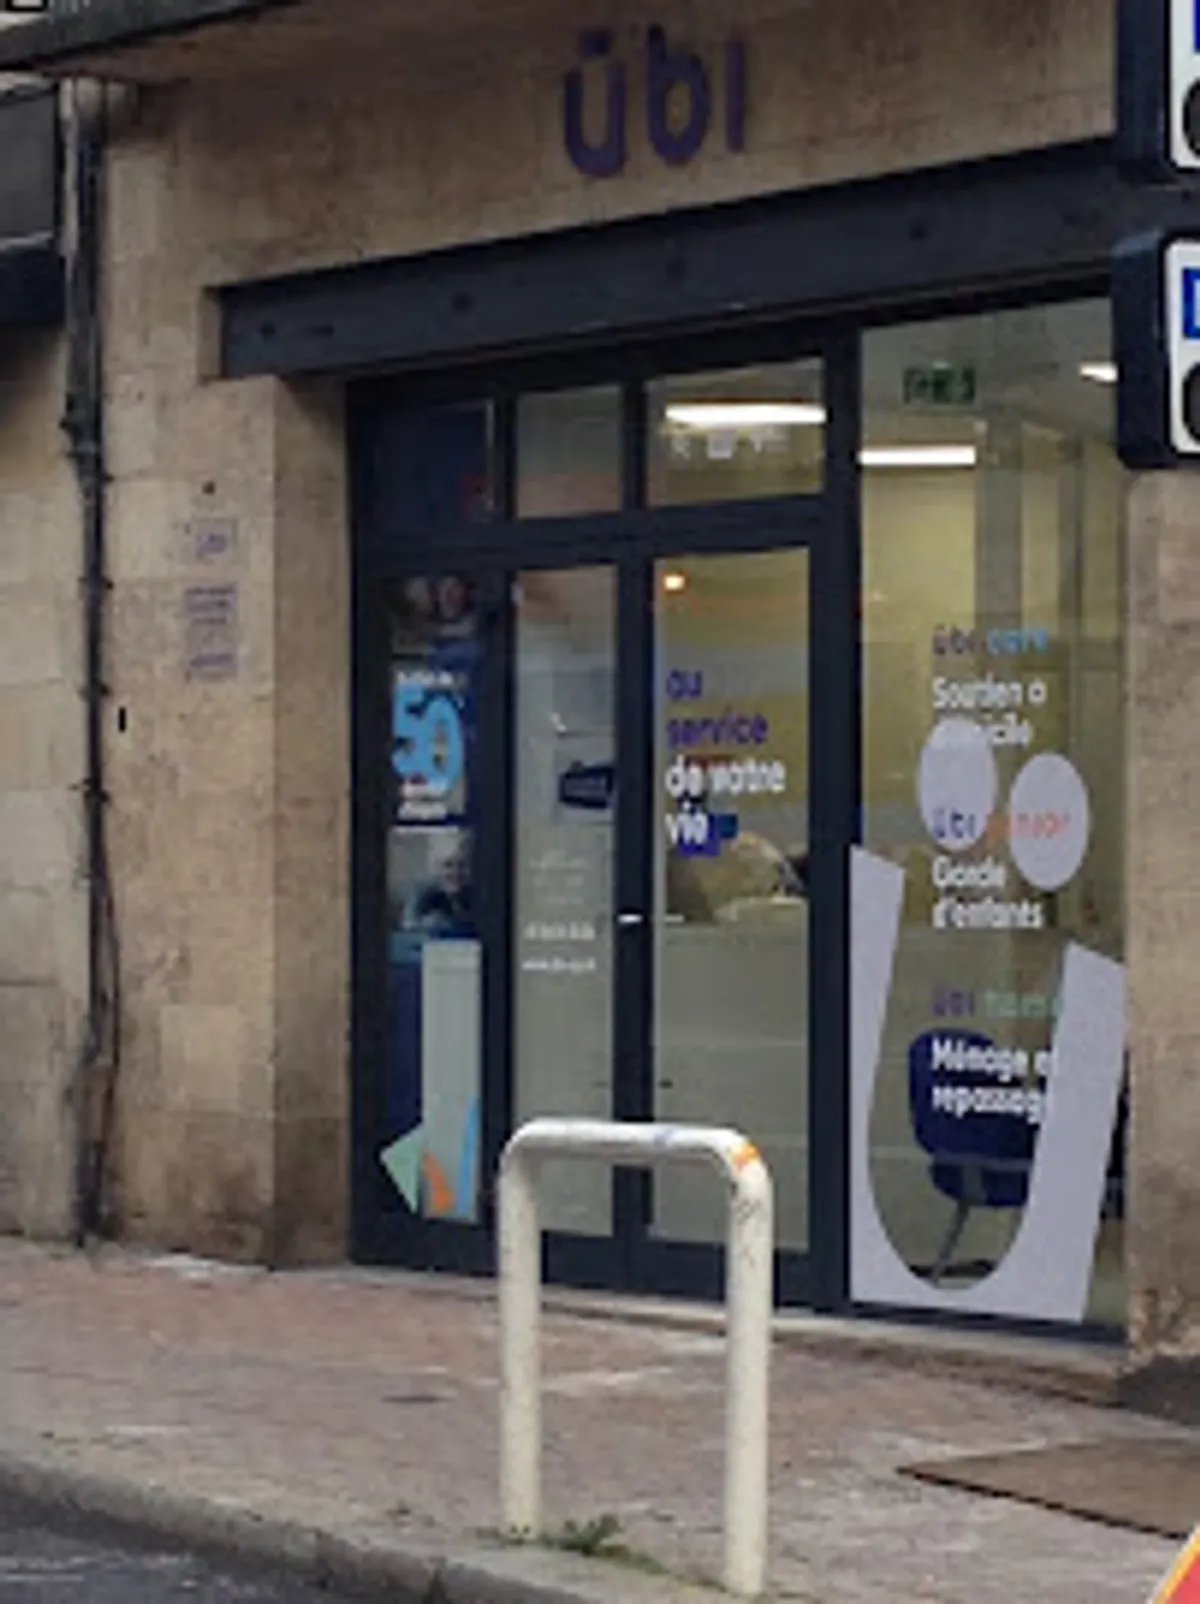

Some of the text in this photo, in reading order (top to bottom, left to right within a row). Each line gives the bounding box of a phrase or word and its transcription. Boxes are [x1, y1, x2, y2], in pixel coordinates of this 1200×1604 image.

[666, 669, 703, 698] au
[932, 671, 1022, 708] Soutien
[666, 711, 769, 748] service
[665, 754, 787, 798] de votre
[665, 801, 710, 844] vie
